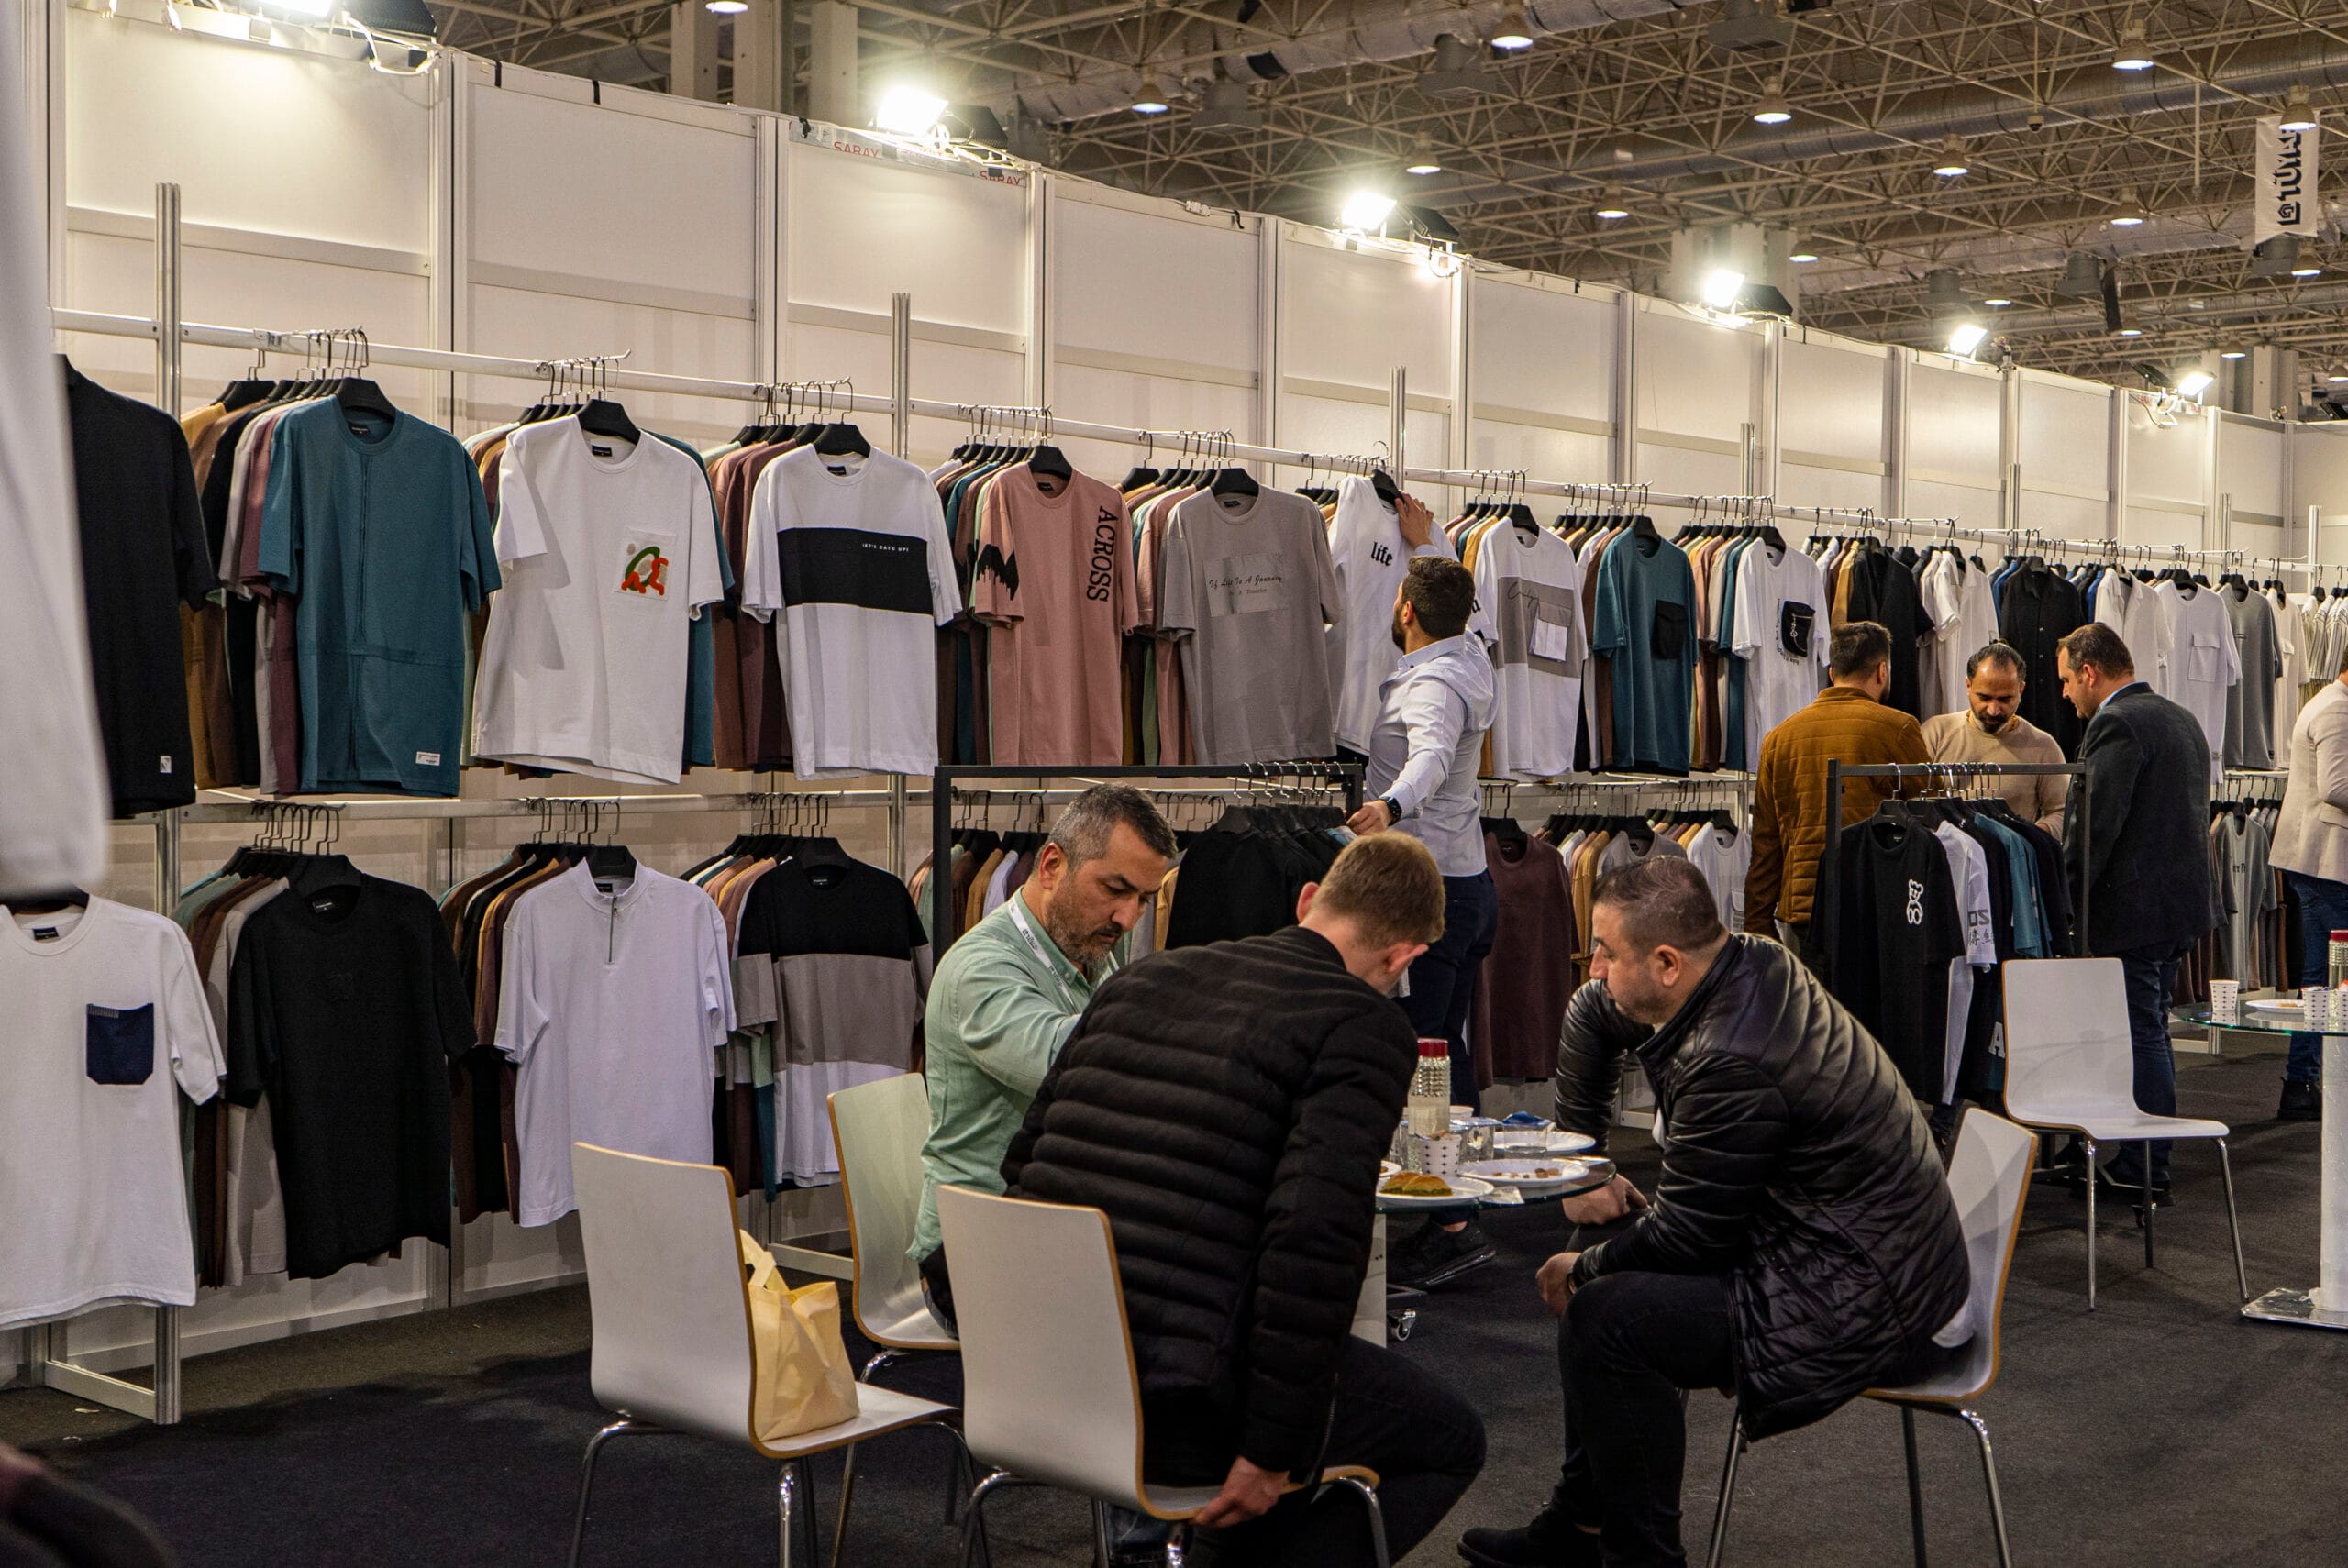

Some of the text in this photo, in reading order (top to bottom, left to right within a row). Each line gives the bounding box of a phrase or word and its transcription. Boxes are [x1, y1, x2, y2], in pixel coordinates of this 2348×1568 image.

[2272, 128, 2302, 202] TÜYA
[1085, 505, 1119, 602] ACROSS
[1370, 541, 1393, 567] life
